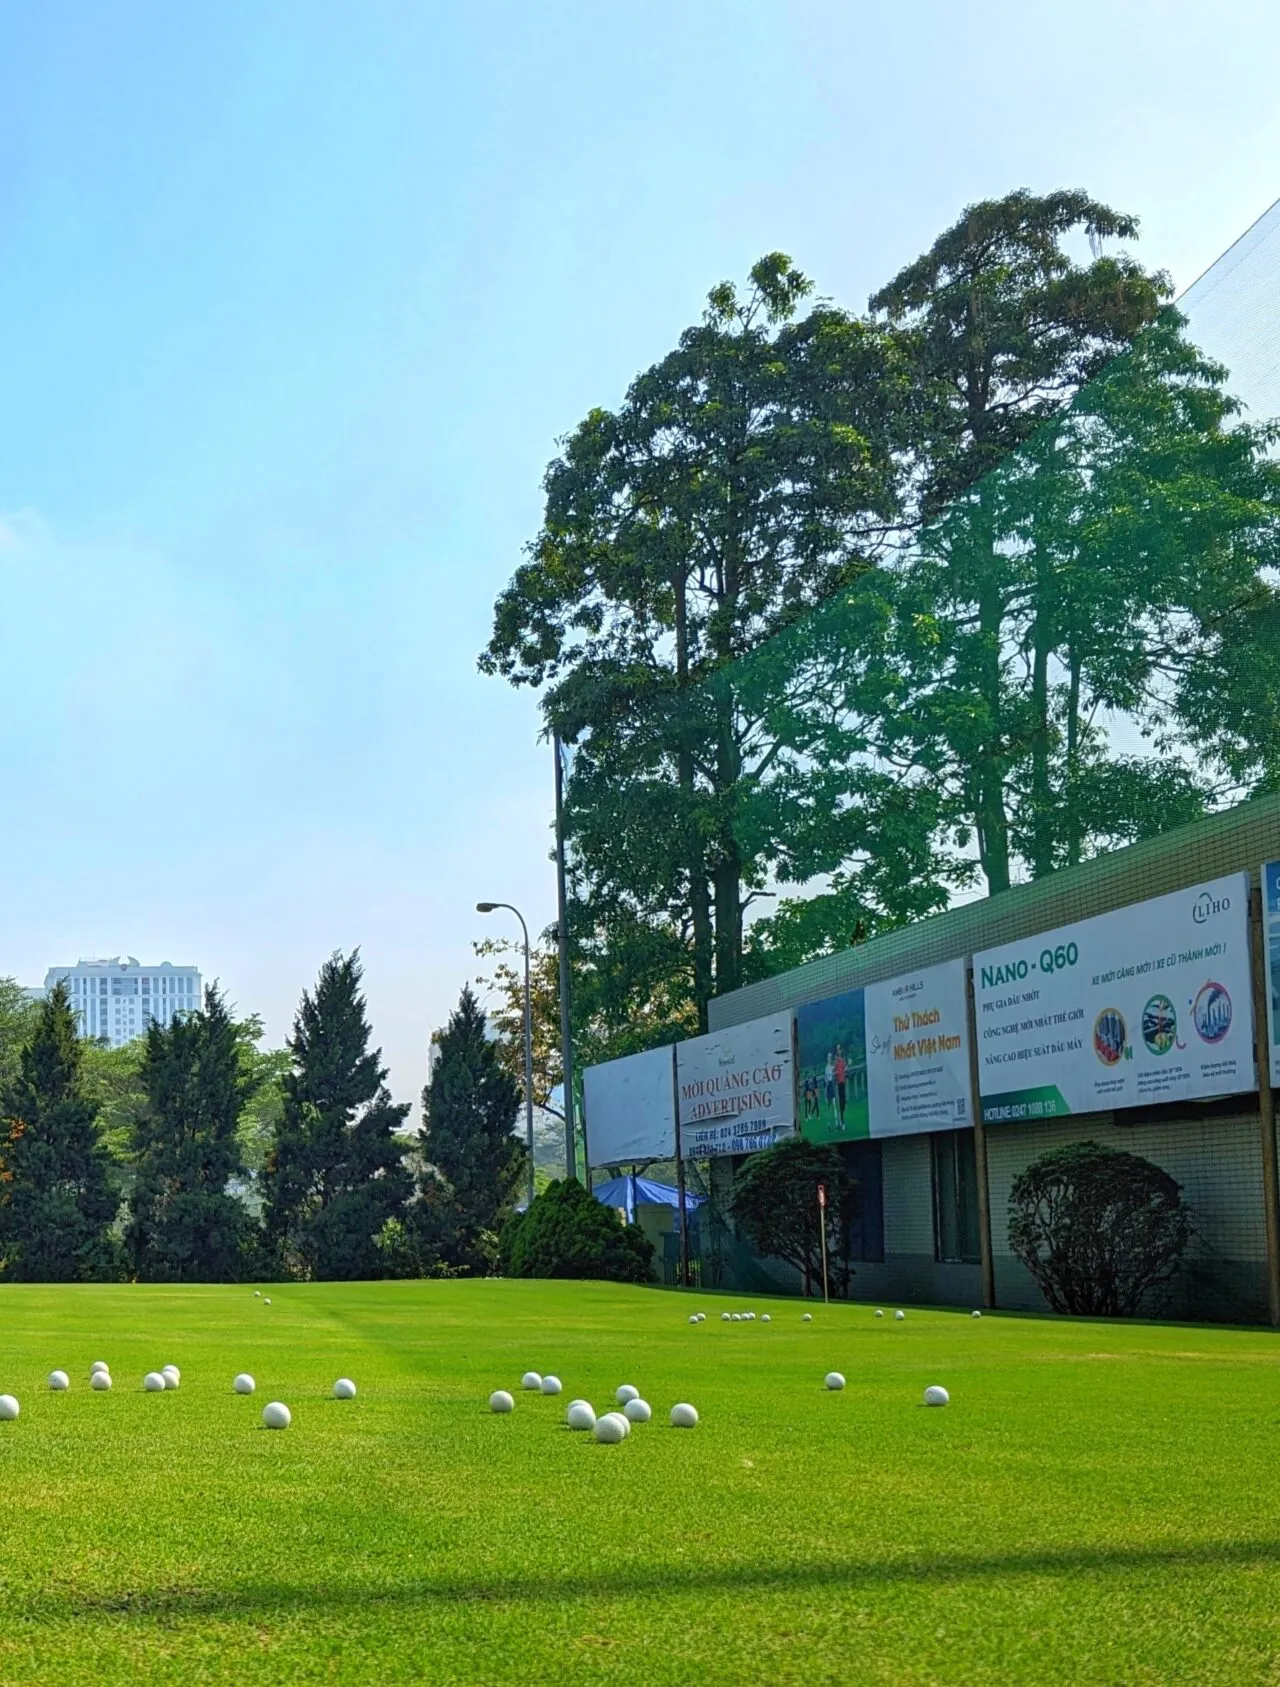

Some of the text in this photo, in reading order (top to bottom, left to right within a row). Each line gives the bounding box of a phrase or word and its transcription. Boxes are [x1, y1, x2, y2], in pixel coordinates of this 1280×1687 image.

[981, 960, 1028, 989] NANO
[1040, 942, 1079, 974] Q60
[1091, 975, 1100, 985] XE
[1101, 971, 1116, 983] MỚI
[1117, 966, 1135, 980] CÀNG
[1136, 961, 1152, 974] MỚI
[1156, 959, 1165, 970] XE
[1167, 953, 1177, 966] CŨ
[1178, 949, 1204, 964] THÀNH
[1205, 942, 1222, 957] MỚI
[996, 999, 1008, 1009] GIA
[893, 1007, 940, 1032] Thử Thách
[984, 1027, 1001, 1039] CÔNG
[1001, 1023, 1019, 1035] NGHỆ
[1052, 1011, 1066, 1025] THẾ
[894, 1040, 916, 1061] Nhất
[917, 1038, 937, 1059] Việt
[939, 1034, 961, 1052] Nam
[1003, 1052, 1017, 1063] CAO
[682, 1078, 704, 1100] MỜI
[707, 1070, 749, 1097] QUẢNG
[691, 1090, 772, 1119] ADVERTISING
